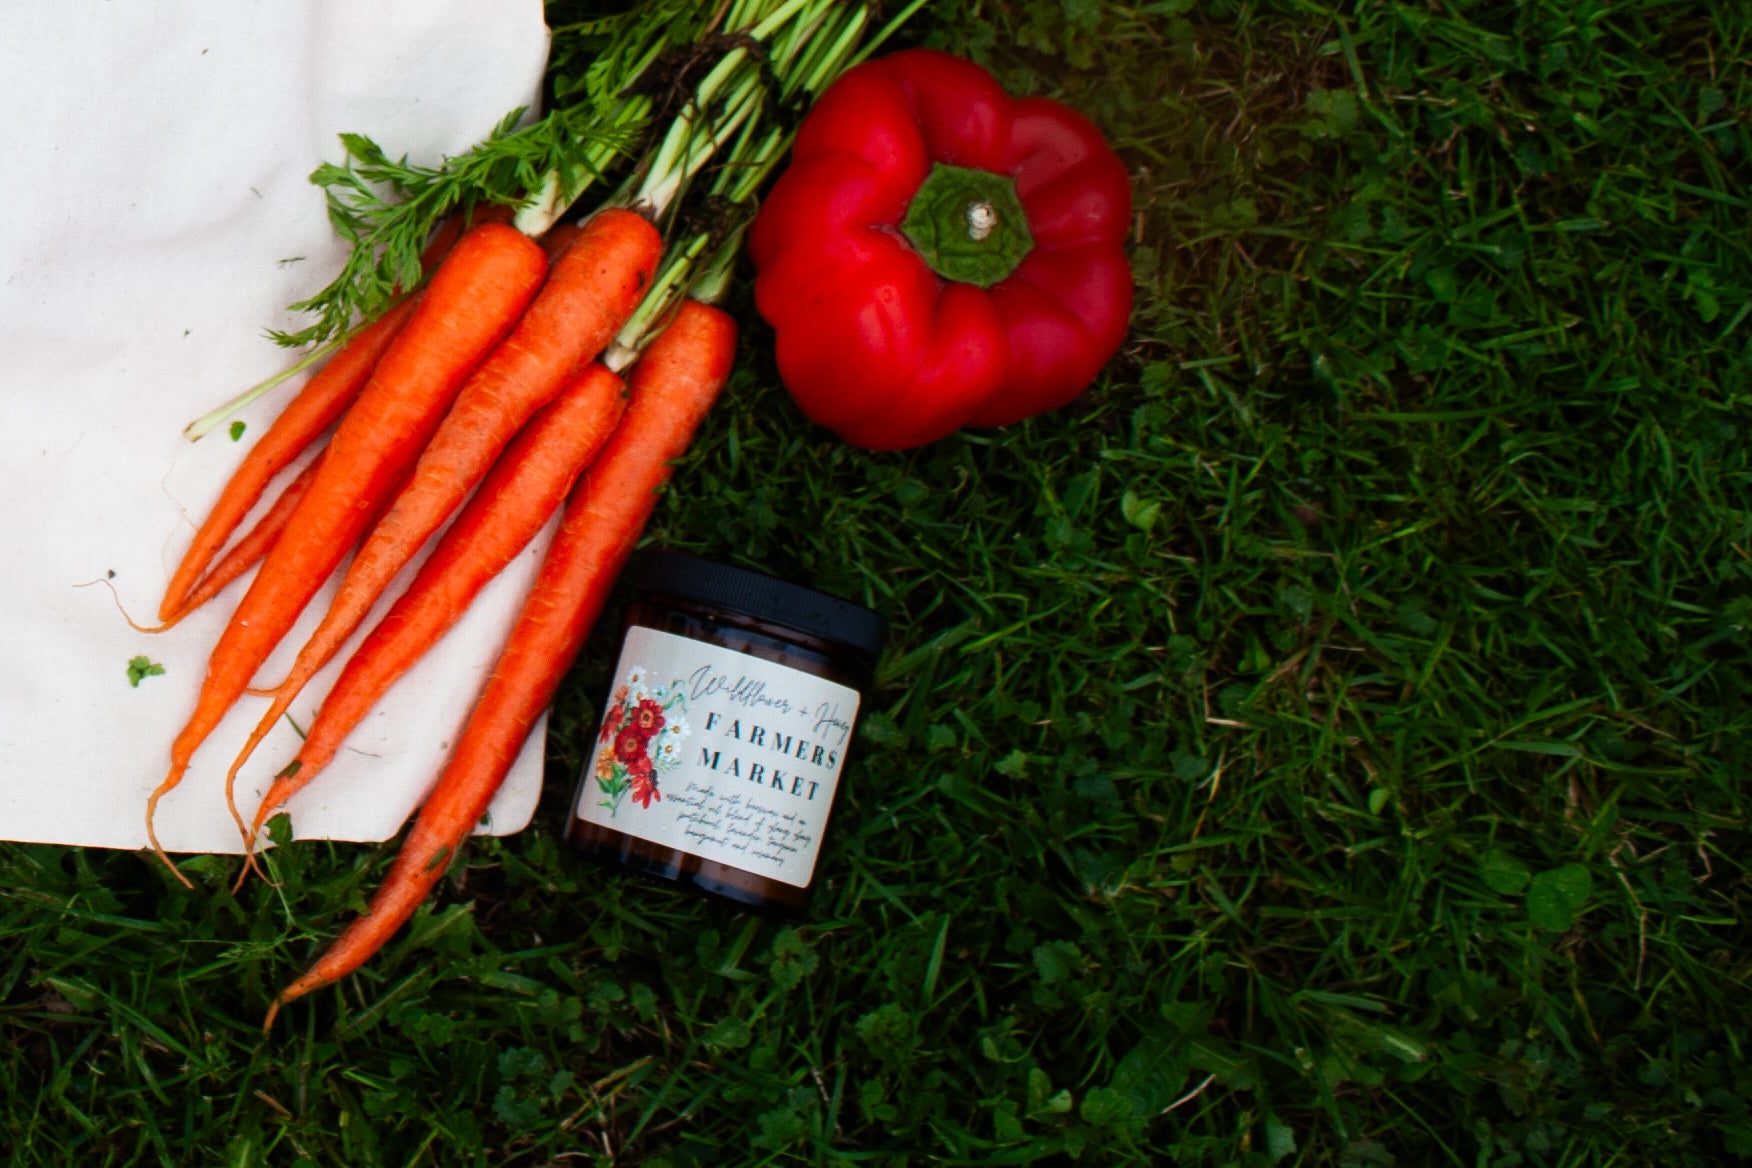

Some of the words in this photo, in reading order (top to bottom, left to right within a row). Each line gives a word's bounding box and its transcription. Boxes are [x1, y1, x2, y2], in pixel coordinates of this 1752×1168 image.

[688, 664, 791, 715] Wildflower
[704, 711, 838, 770] FARMERS
[697, 747, 820, 801] MARKET
